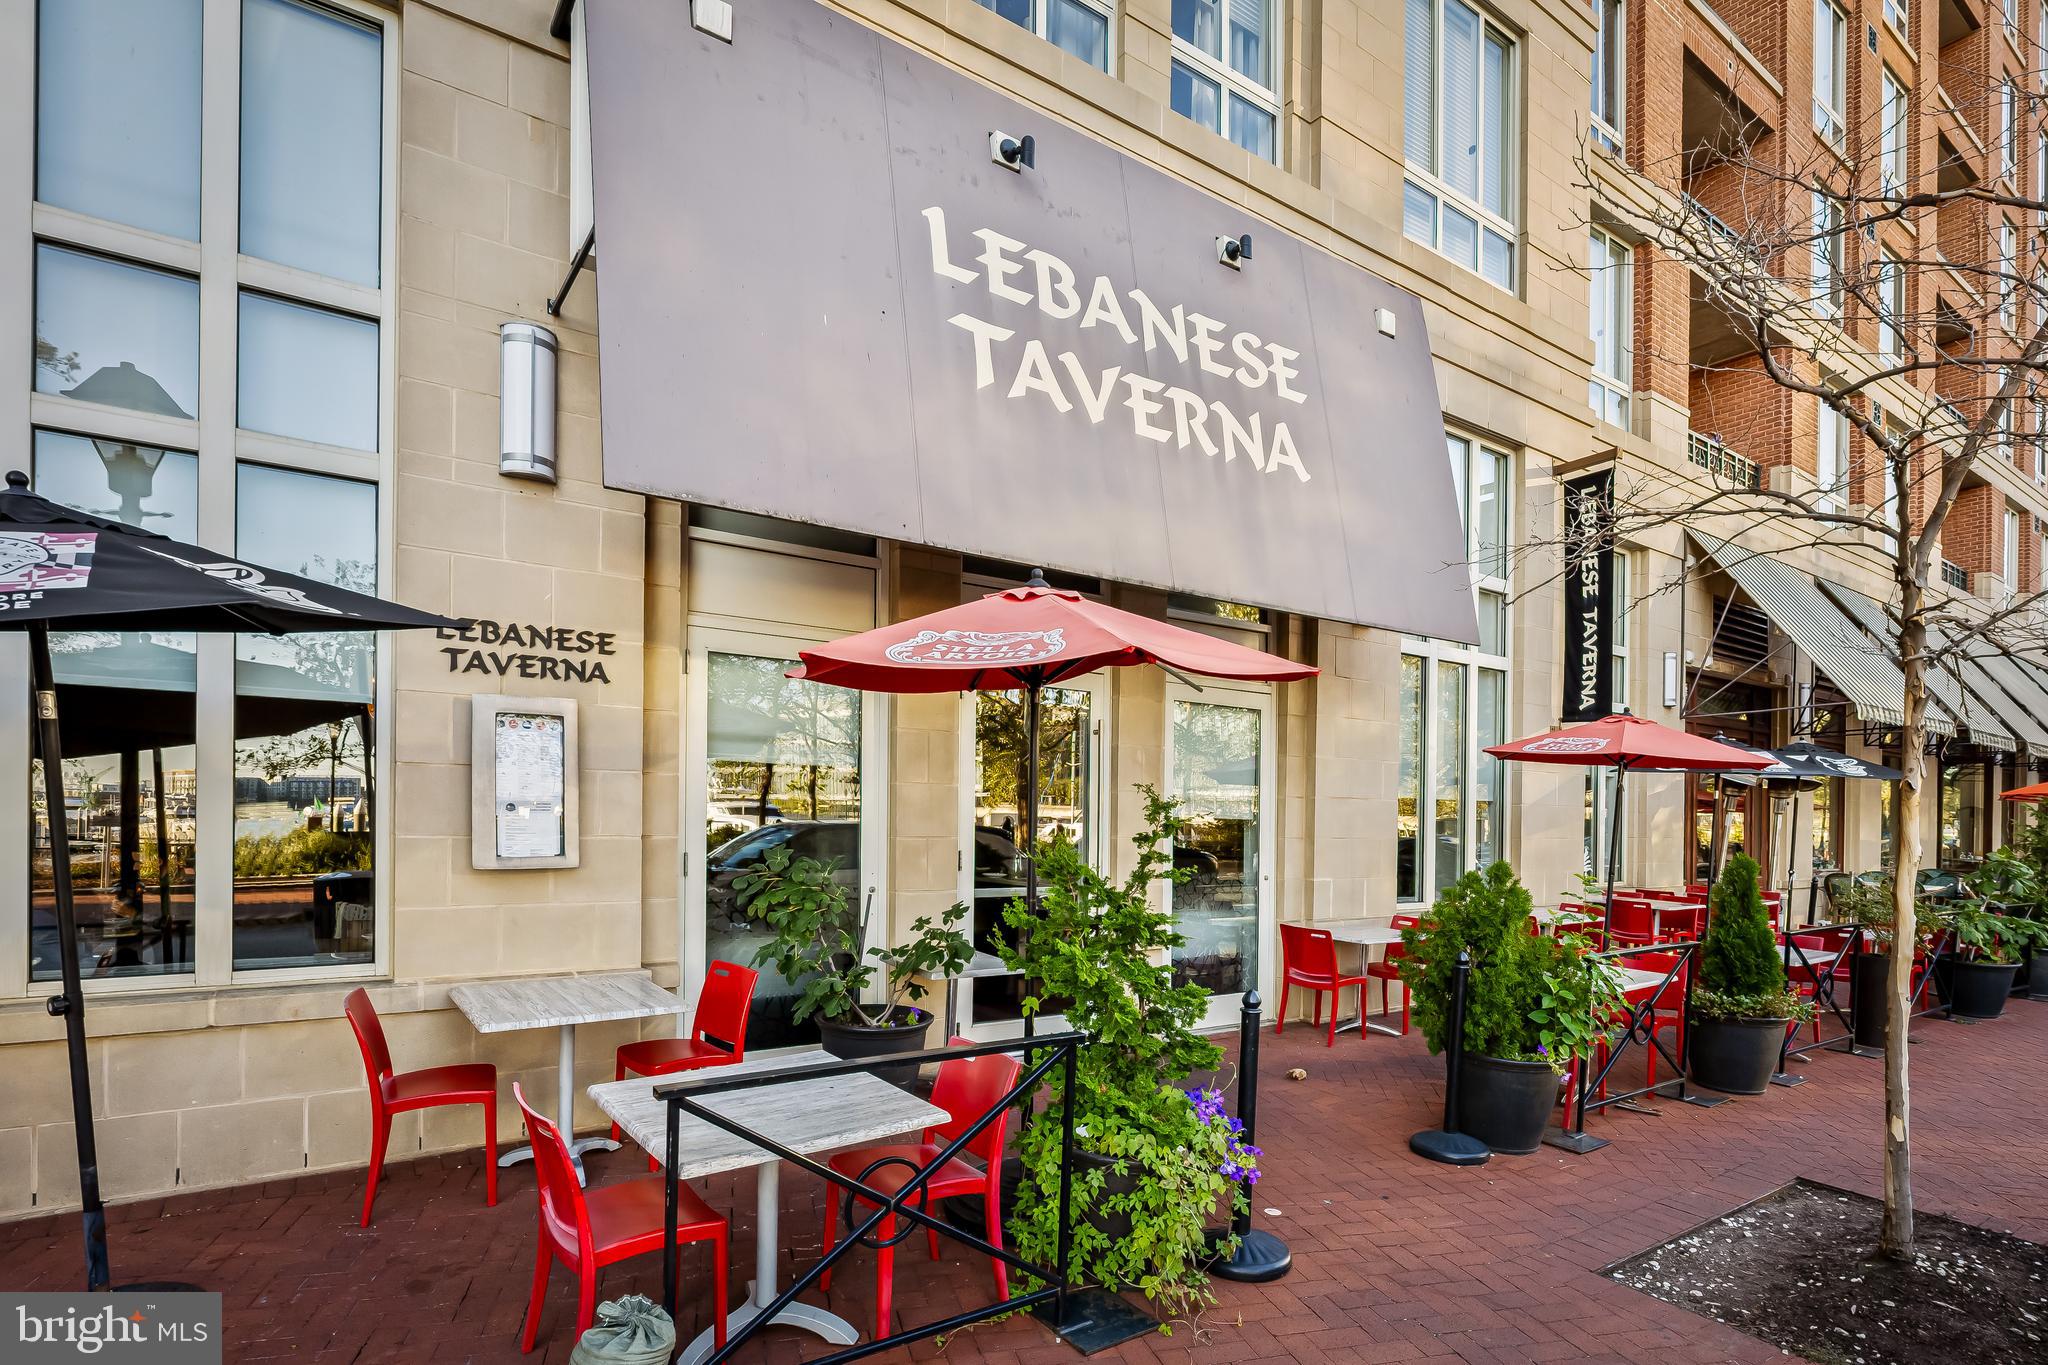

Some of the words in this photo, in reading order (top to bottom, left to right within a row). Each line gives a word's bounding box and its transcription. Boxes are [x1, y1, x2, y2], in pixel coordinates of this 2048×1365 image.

[921, 206, 1308, 404] LEBANESE
[947, 313, 1311, 482] TAVERNA
[440, 647, 611, 684] TAVERNA
[924, 650, 1030, 660] ARTOIS
[932, 643, 1034, 652] STELLA
[1579, 606, 1598, 711] TAVERNA
